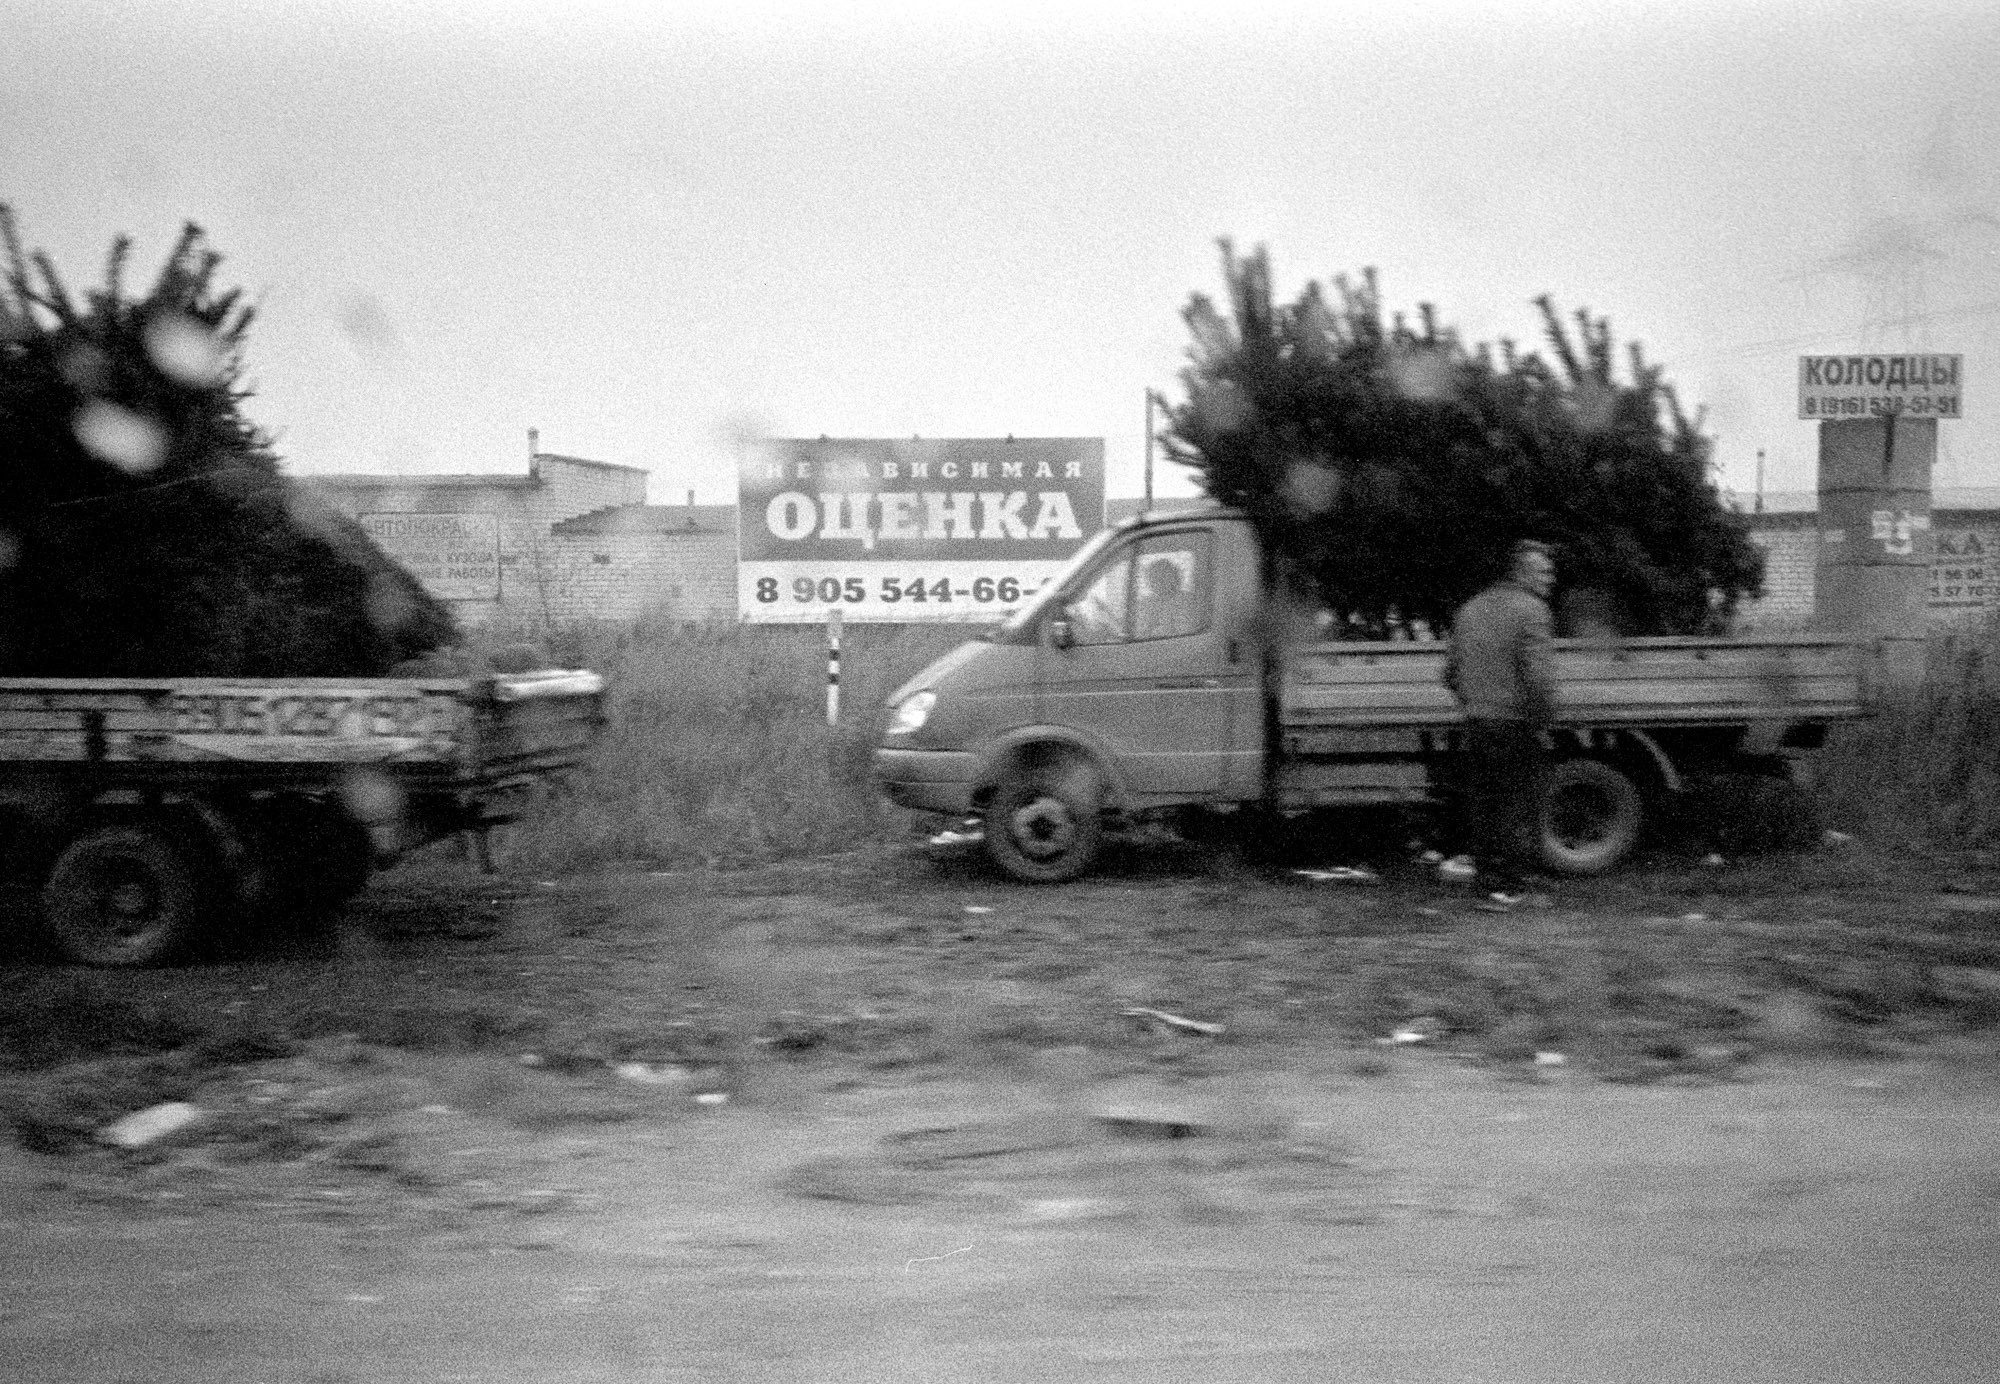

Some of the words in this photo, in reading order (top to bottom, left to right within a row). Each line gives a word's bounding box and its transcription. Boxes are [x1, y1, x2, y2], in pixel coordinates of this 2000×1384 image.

[1805, 357, 1958, 391] КОЛОДЦЫ
[1805, 396, 1817, 415] 8
[766, 491, 1083, 549] ОЦЕНКА
[756, 577, 779, 602] 8
[792, 577, 866, 602] 905
[880, 577, 1052, 603] 544-66-
